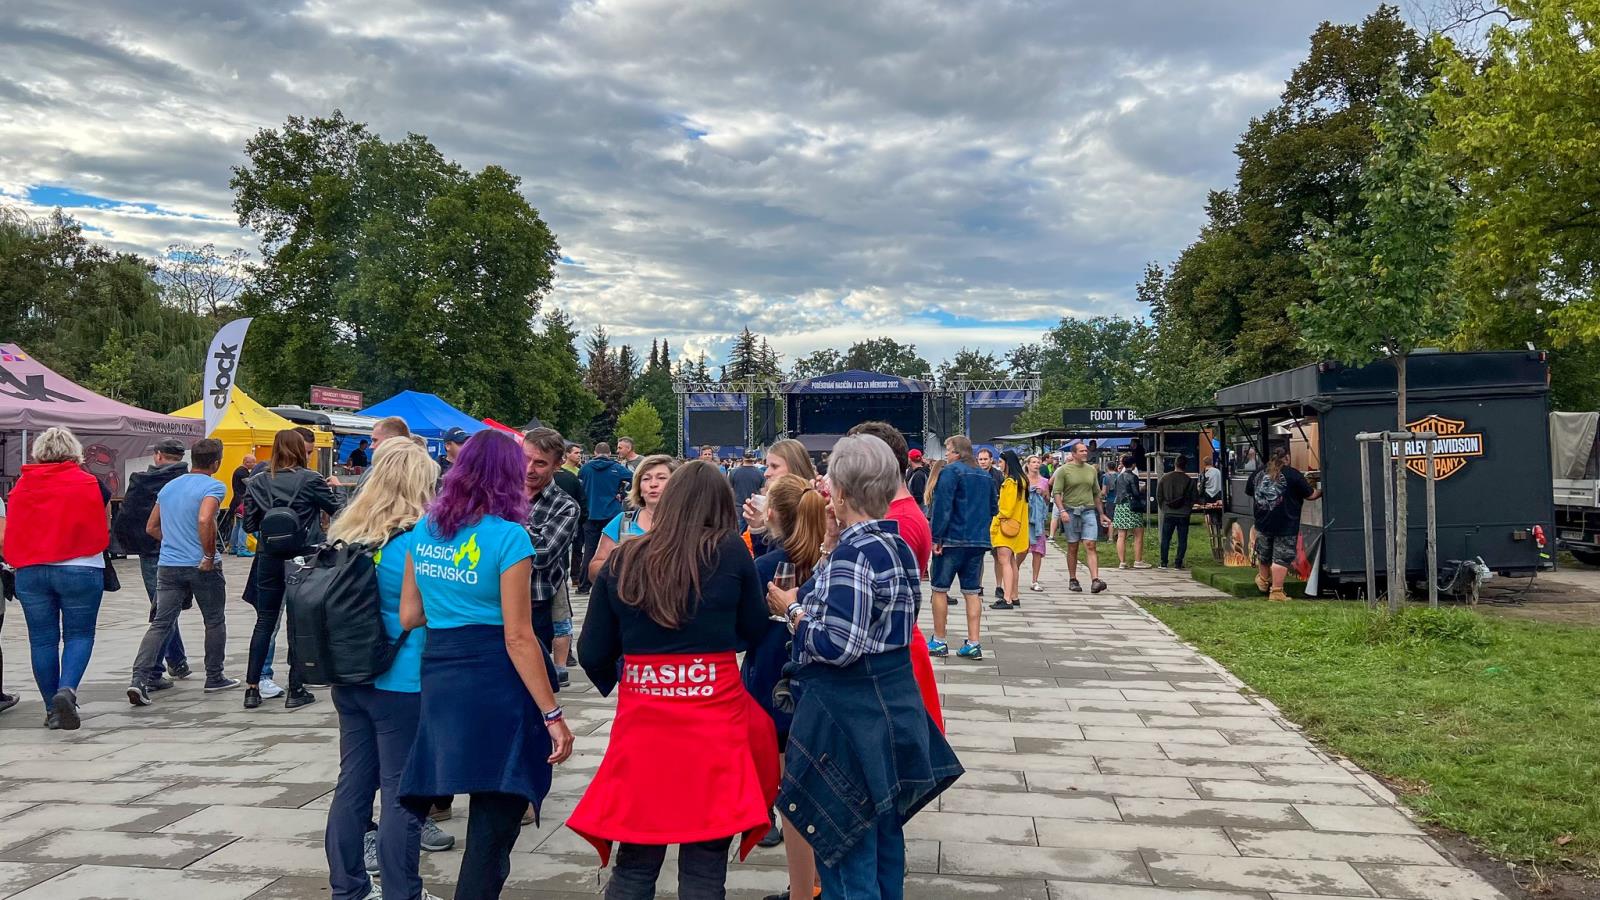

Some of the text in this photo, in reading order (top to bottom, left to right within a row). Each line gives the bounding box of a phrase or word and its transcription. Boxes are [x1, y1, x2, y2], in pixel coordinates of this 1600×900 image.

[209, 342, 238, 409] clock
[1090, 410, 1113, 421] FOOD
[1411, 419, 1457, 434] MOTOR
[1391, 440, 1427, 456] HRLEY
[1412, 457, 1460, 477] COPANY
[416, 543, 457, 562] HASIČI
[415, 560, 479, 585] HŘENSKO
[625, 658, 717, 684] HASIČI
